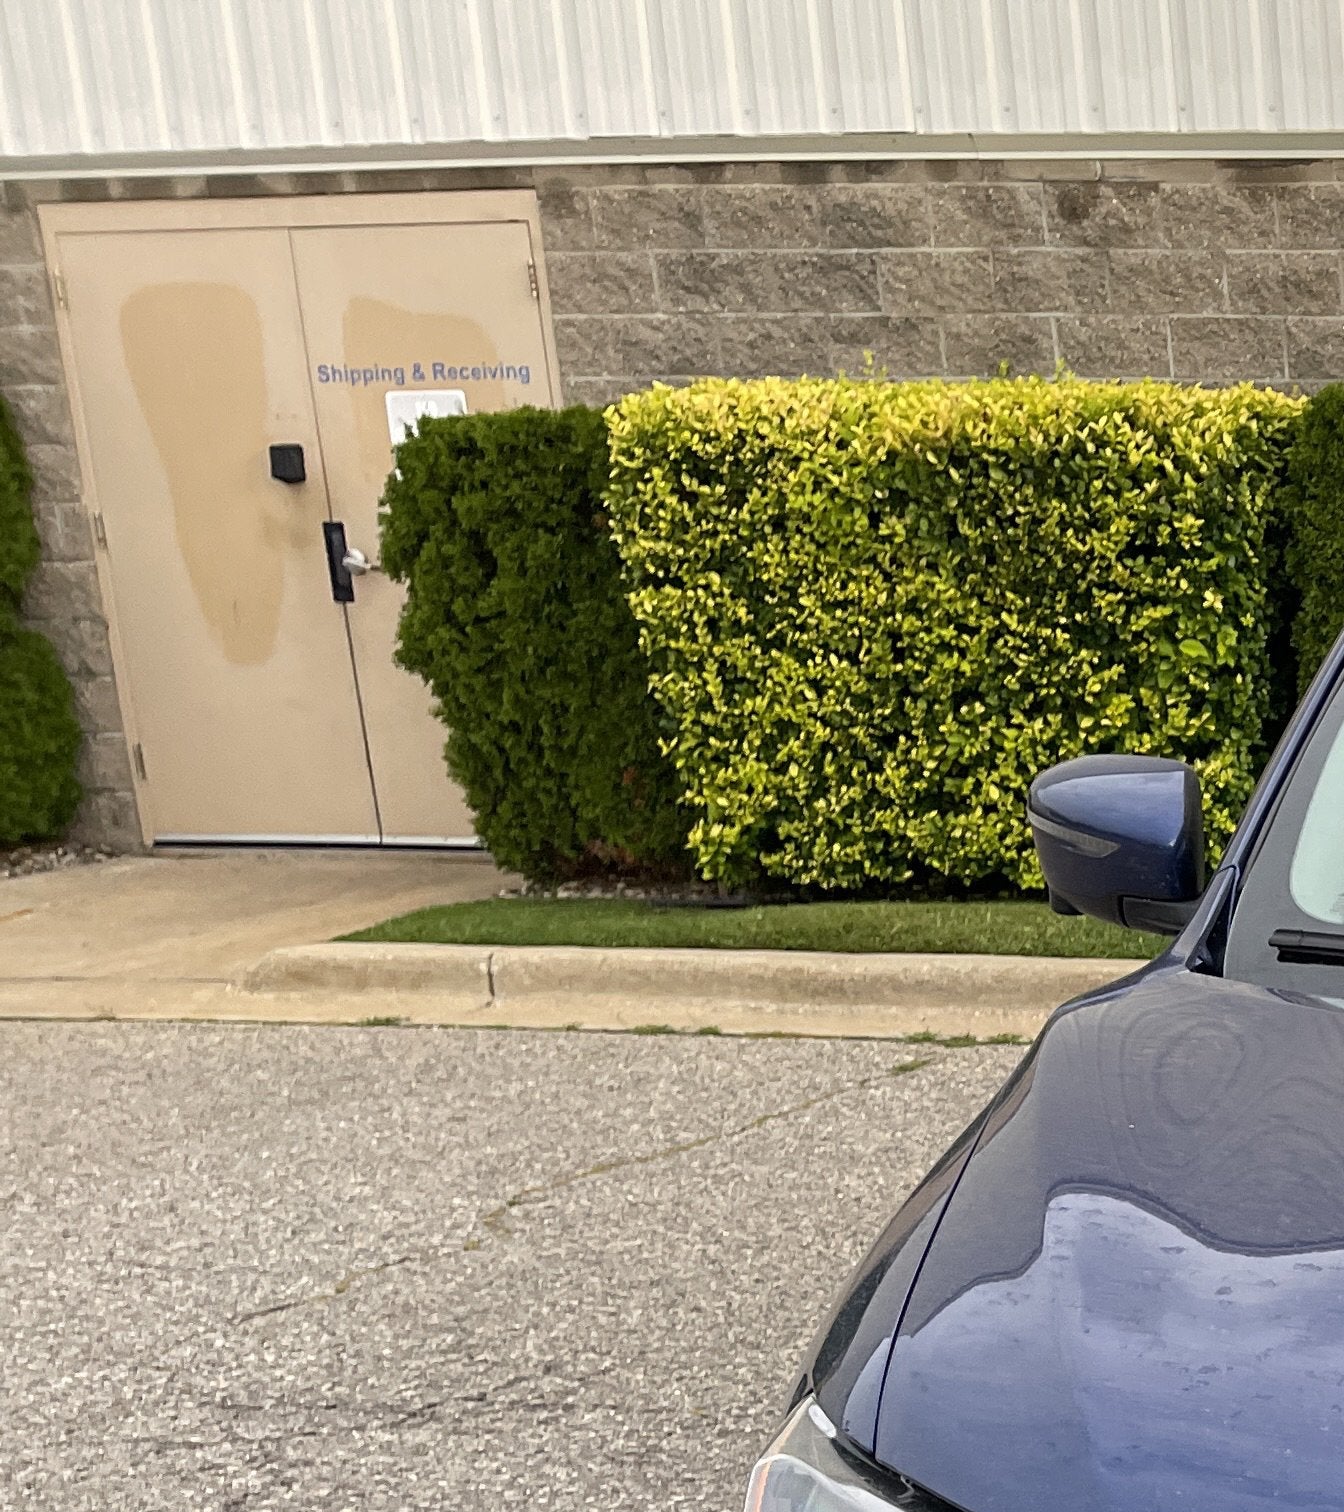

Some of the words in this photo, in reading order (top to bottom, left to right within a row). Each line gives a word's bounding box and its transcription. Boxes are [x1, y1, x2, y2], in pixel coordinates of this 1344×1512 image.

[317, 363, 405, 386] Shipping
[412, 362, 426, 382] &
[431, 361, 531, 384] Receiving
